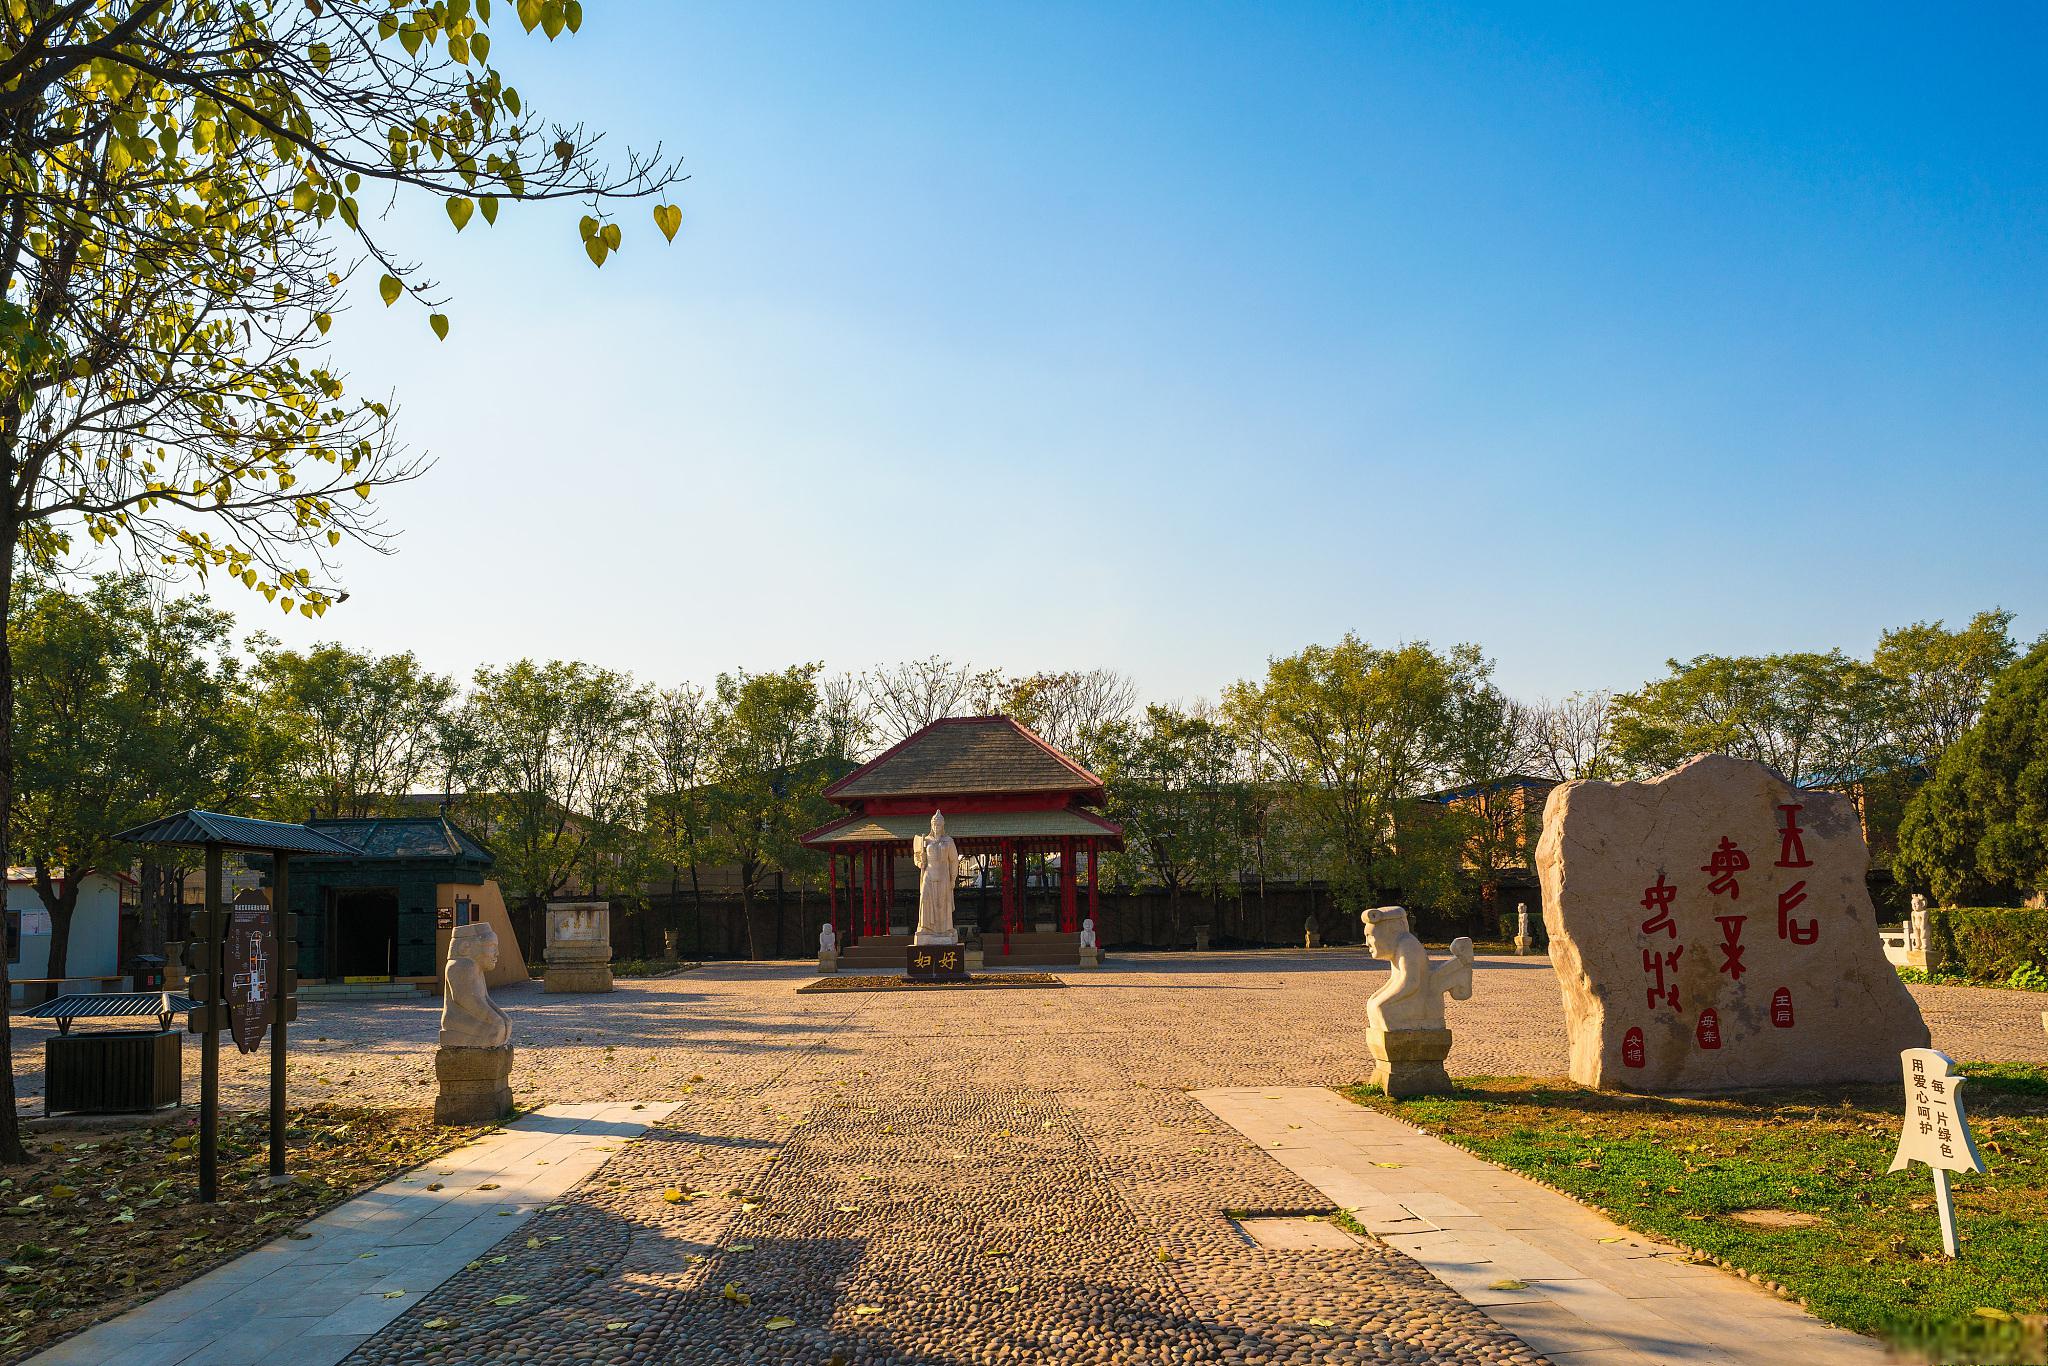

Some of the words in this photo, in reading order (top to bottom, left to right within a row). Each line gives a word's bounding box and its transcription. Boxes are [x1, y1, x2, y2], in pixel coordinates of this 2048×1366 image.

[914, 951, 957, 970] 妇好
[1775, 995, 1791, 1022] 王后
[1701, 1015, 1717, 1043] 母亲
[1626, 1035, 1642, 1062] 女将
[1912, 1058, 1933, 1135] 用爱心呵护
[1931, 1079, 1954, 1159] 每一片绿色
